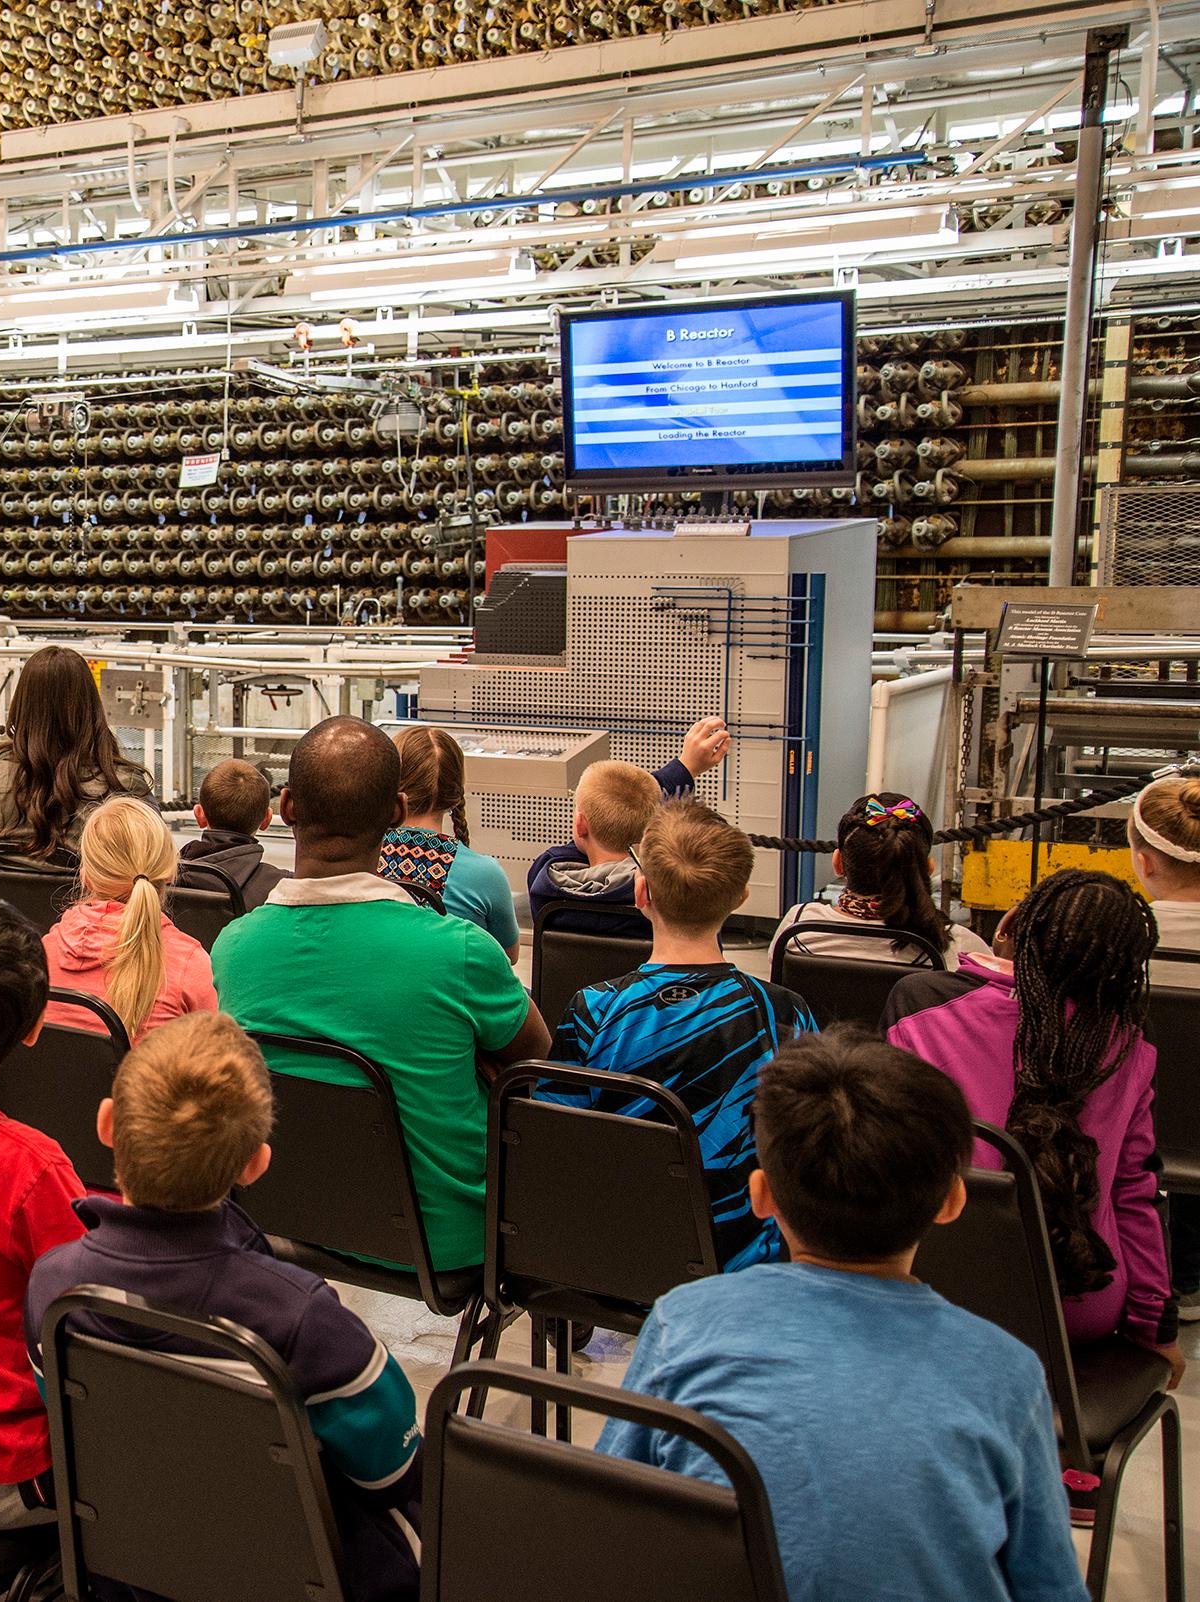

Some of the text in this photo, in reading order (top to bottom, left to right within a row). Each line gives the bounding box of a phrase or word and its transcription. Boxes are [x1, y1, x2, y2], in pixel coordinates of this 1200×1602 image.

[666, 326, 735, 342] B Reactor
[652, 357, 750, 371] Welcome to B Reactor
[645, 379, 758, 395] From Chicago to Hanford
[658, 426, 747, 441] Loading the Reactor
